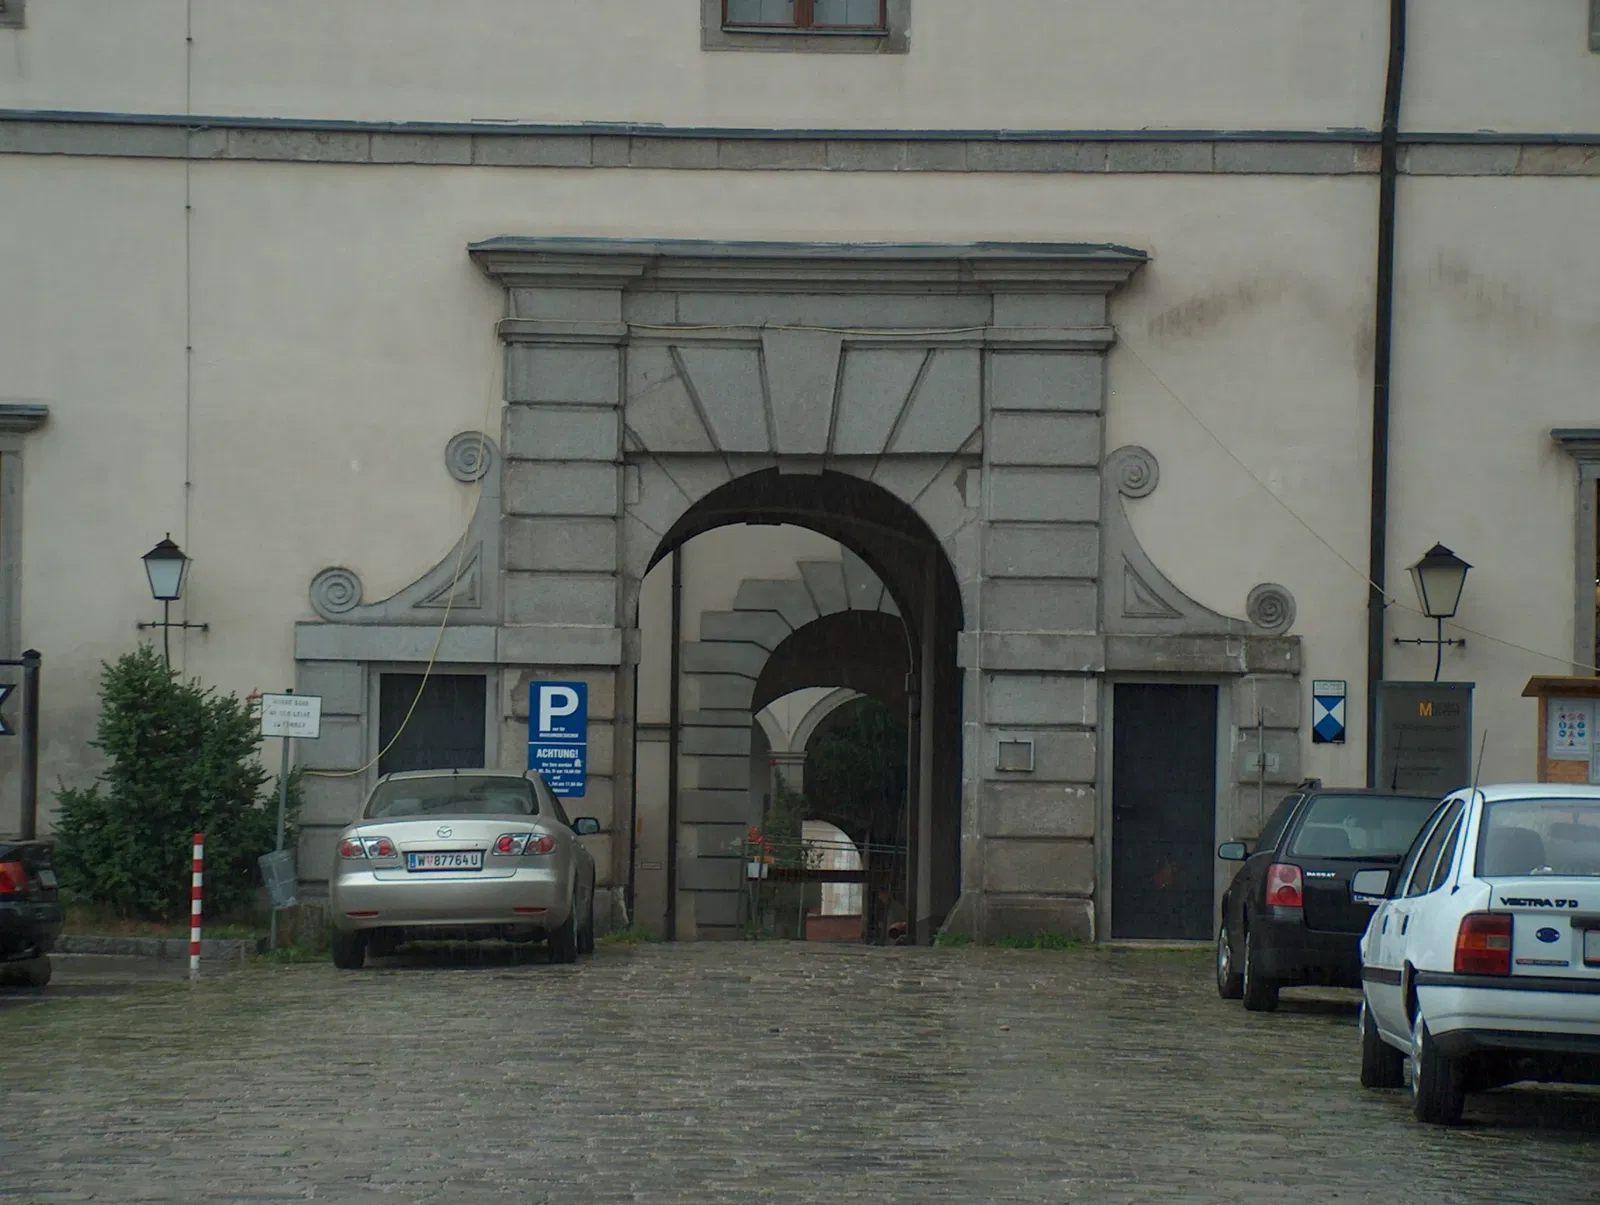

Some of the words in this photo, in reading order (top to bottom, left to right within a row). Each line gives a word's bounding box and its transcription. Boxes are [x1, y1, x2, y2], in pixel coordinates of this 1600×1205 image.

[539, 686, 579, 731] P
[536, 748, 579, 758] ACHTUNG!
[1500, 897, 1554, 908] VECTRA
